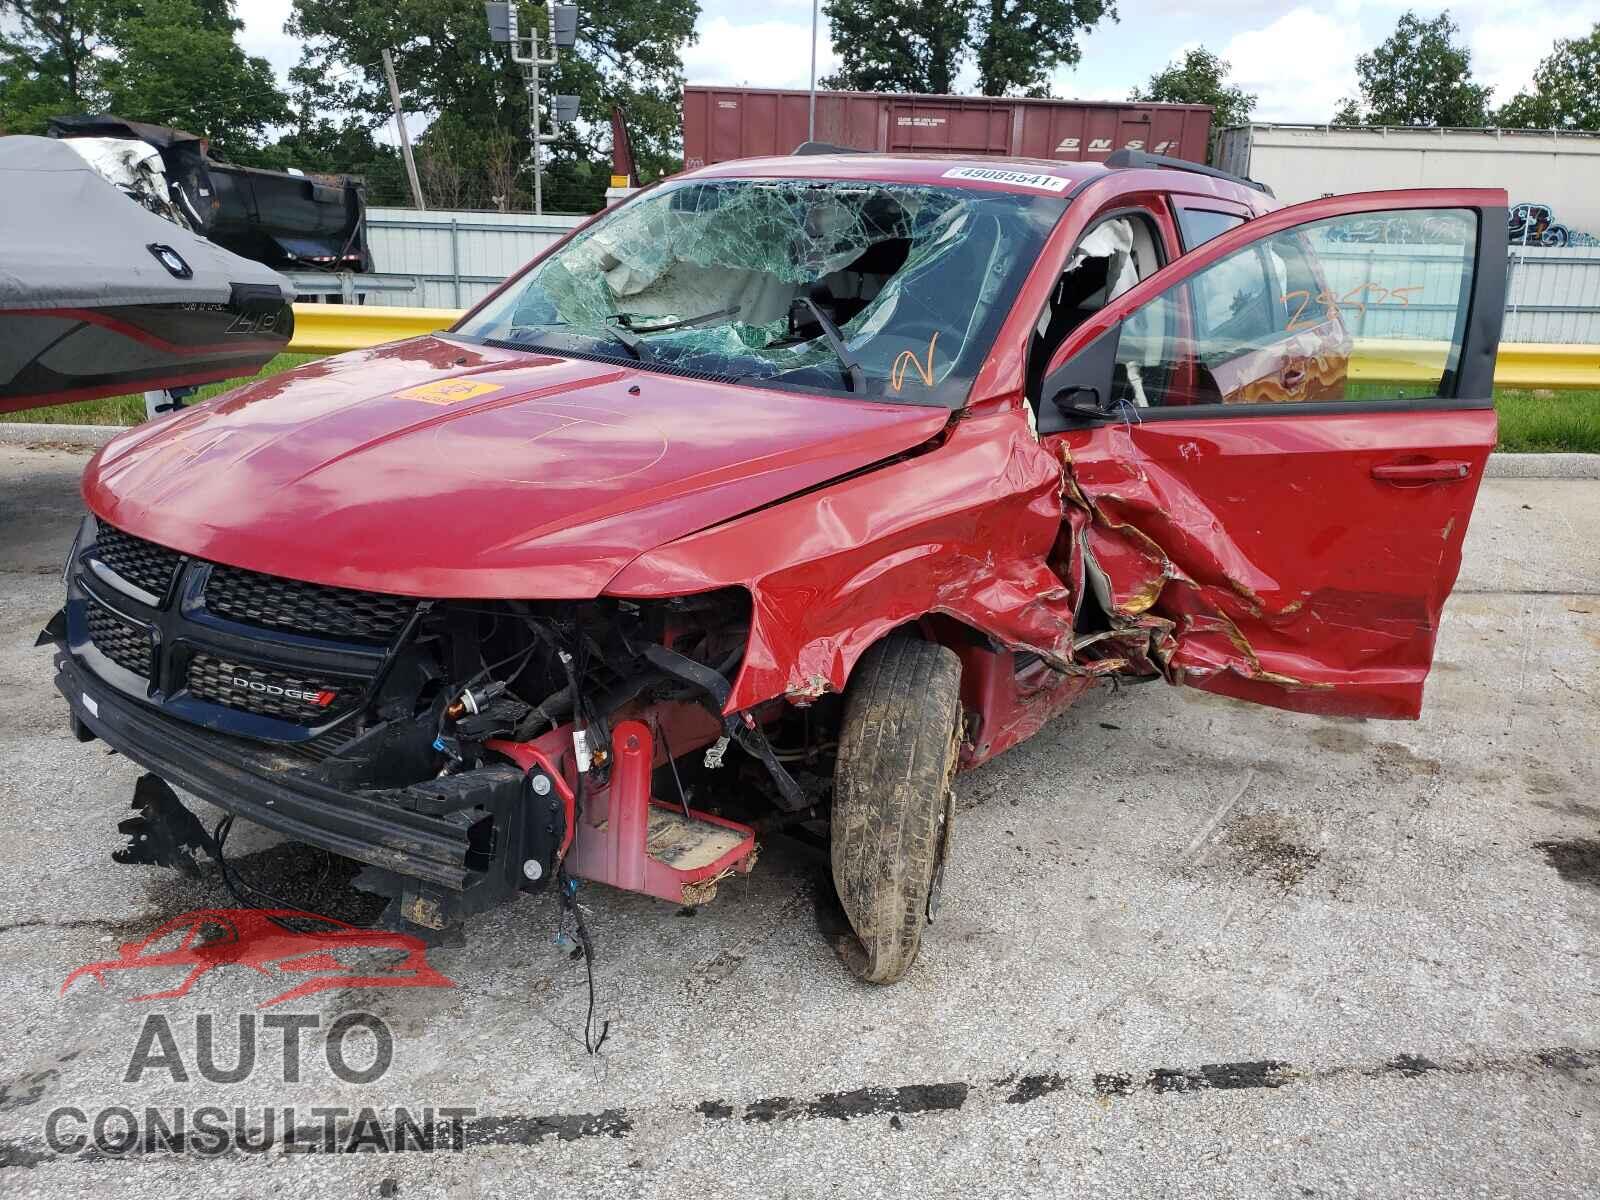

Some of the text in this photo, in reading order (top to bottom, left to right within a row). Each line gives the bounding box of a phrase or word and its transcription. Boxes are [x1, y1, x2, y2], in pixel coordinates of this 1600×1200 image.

[1056, 138, 1178, 152] BNSF
[961, 167, 1051, 186] 49085541
[233, 677, 321, 702] DODGE
